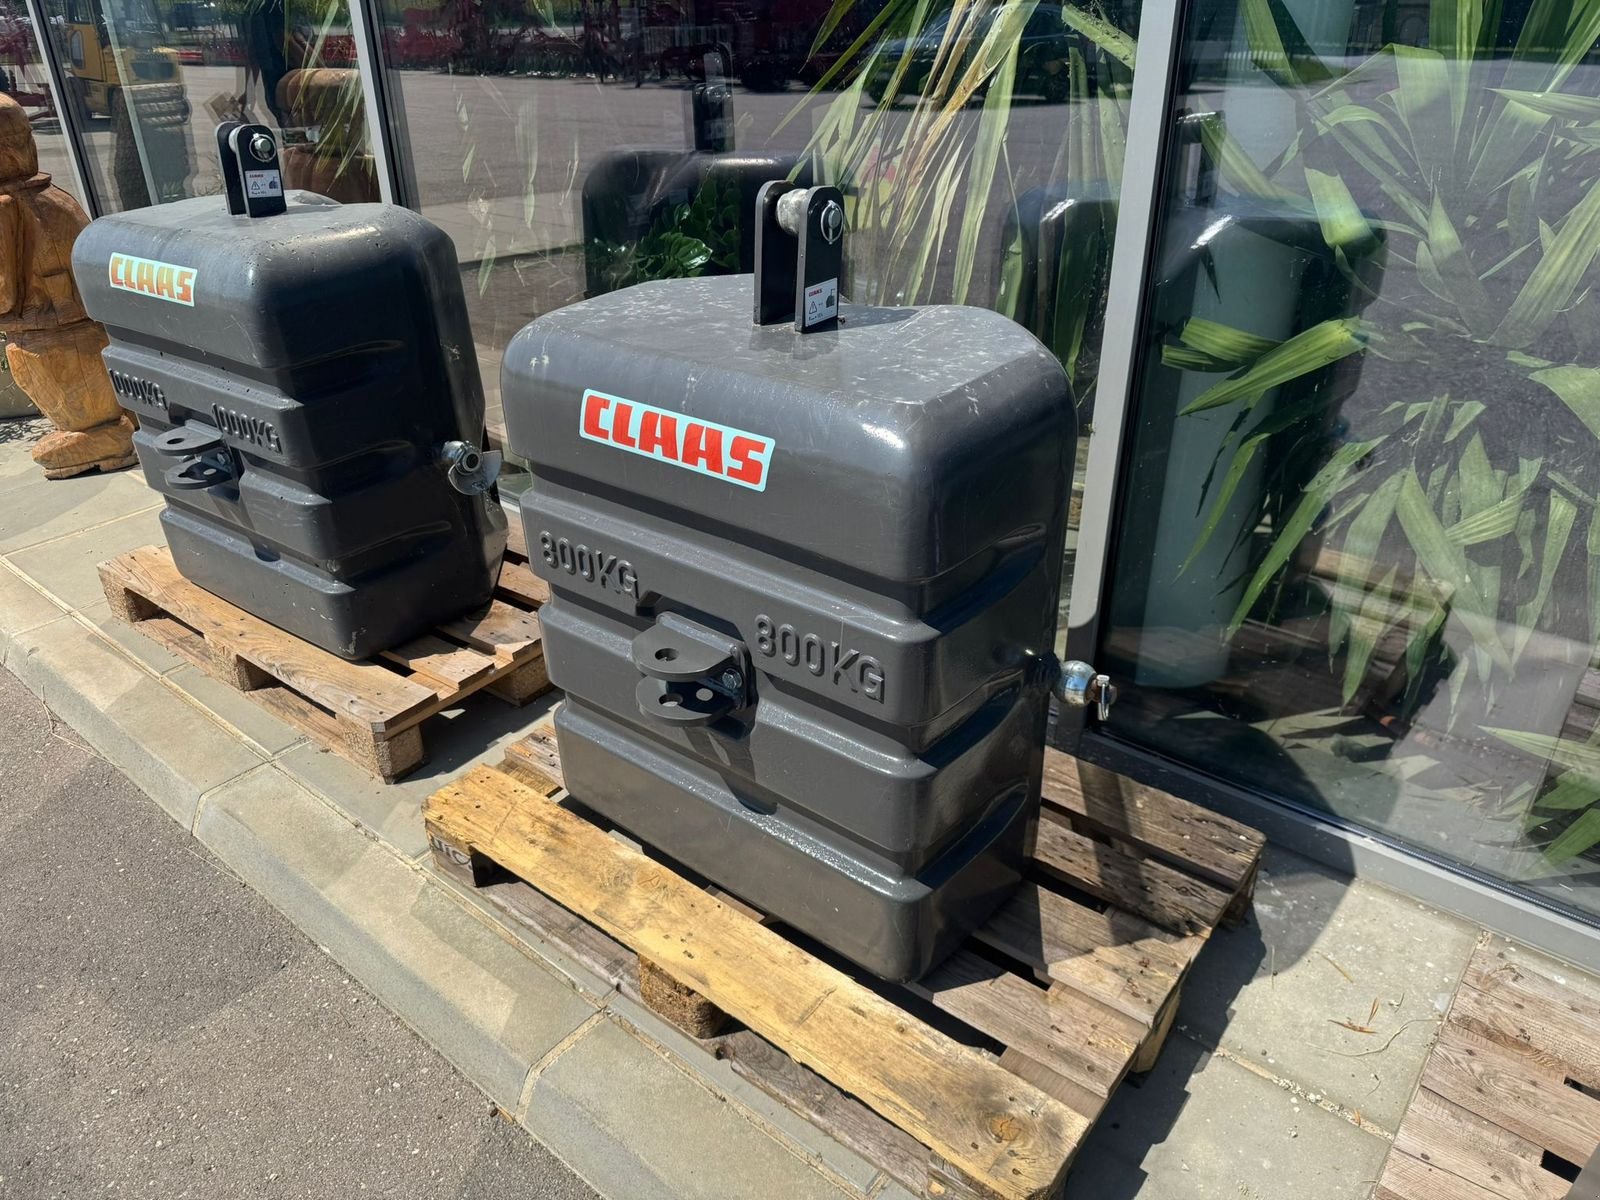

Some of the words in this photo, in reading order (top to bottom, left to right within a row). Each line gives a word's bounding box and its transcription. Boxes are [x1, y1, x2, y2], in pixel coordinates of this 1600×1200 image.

[111, 256, 193, 302] CLAAS
[211, 402, 283, 455] 1000KG
[583, 394, 766, 485] CLAAS
[539, 530, 640, 600] 800KG
[754, 613, 885, 705] 800KG
